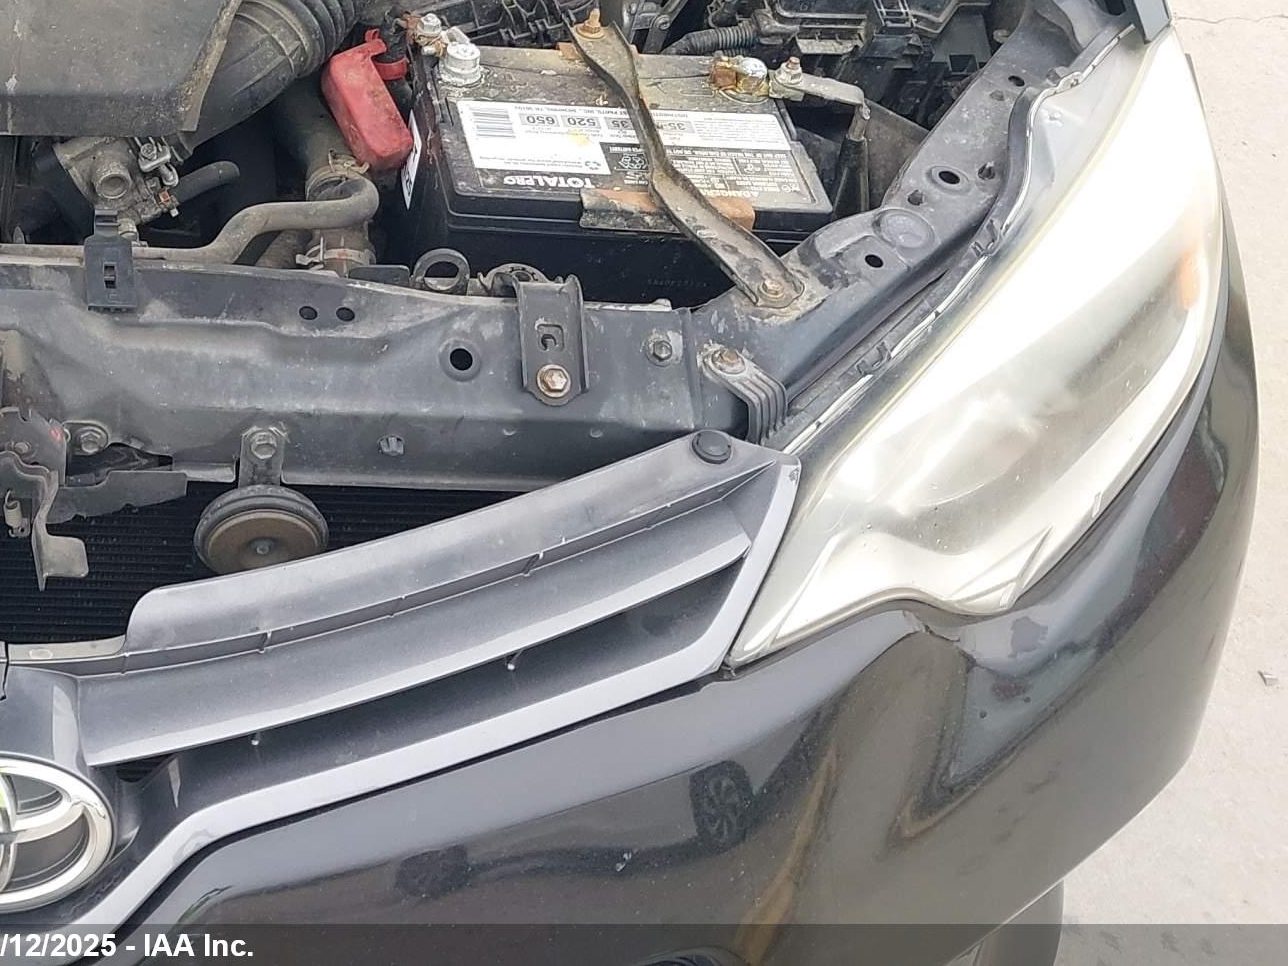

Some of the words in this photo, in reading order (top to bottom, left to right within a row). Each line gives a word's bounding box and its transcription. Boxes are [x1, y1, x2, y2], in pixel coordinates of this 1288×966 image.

[526, 115, 556, 126] 650
[567, 117, 597, 127] 520
[612, 119, 630, 129] 35
[502, 174, 596, 189] TOTALPRO
